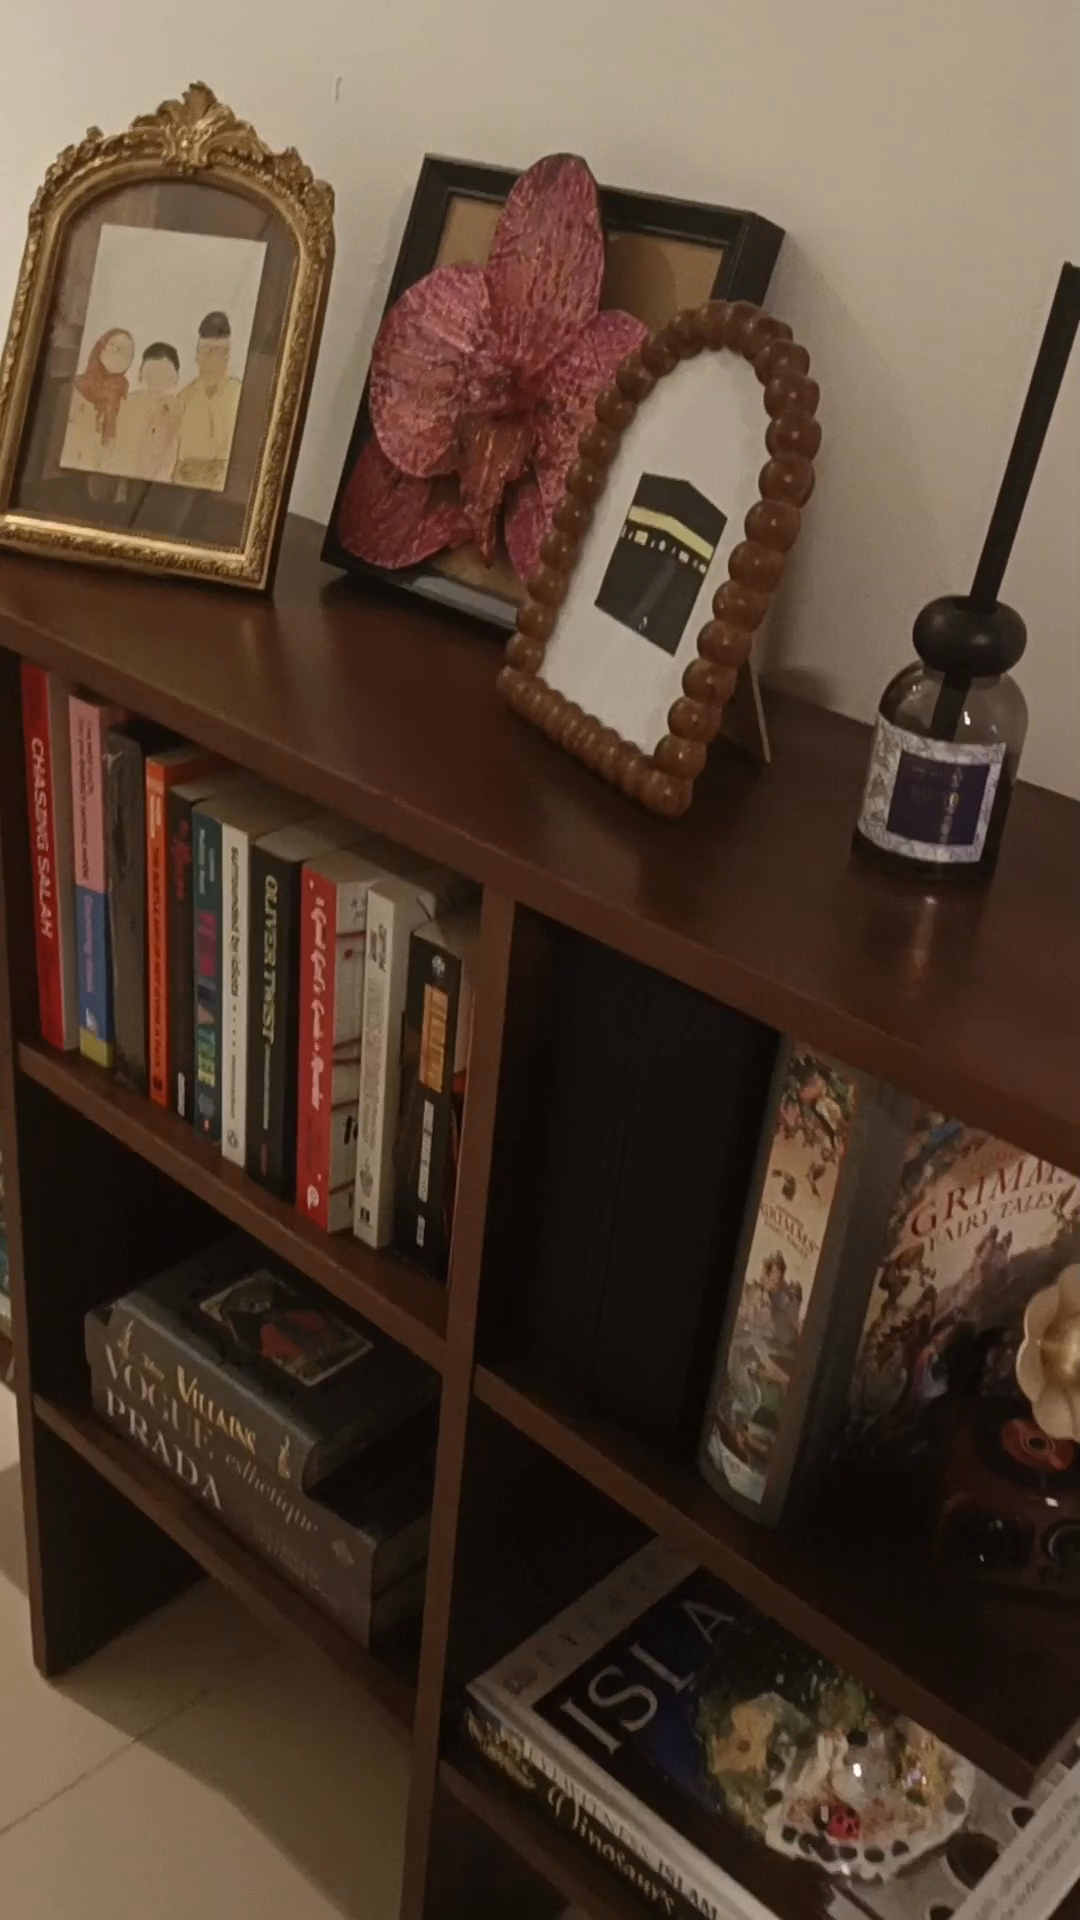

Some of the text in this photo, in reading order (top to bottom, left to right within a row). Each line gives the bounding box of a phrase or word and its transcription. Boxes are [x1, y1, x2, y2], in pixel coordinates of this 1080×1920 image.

[31, 737, 54, 940] CHASING SALAH
[263, 874, 279, 967] OLIVER
[262, 969, 277, 1046] TWIST
[911, 1159, 1063, 1238] GRIMM
[929, 1189, 1058, 1252] FAIRY TALES
[106, 1388, 222, 1510] PRADA
[176, 1363, 257, 1456] VILLAINS
